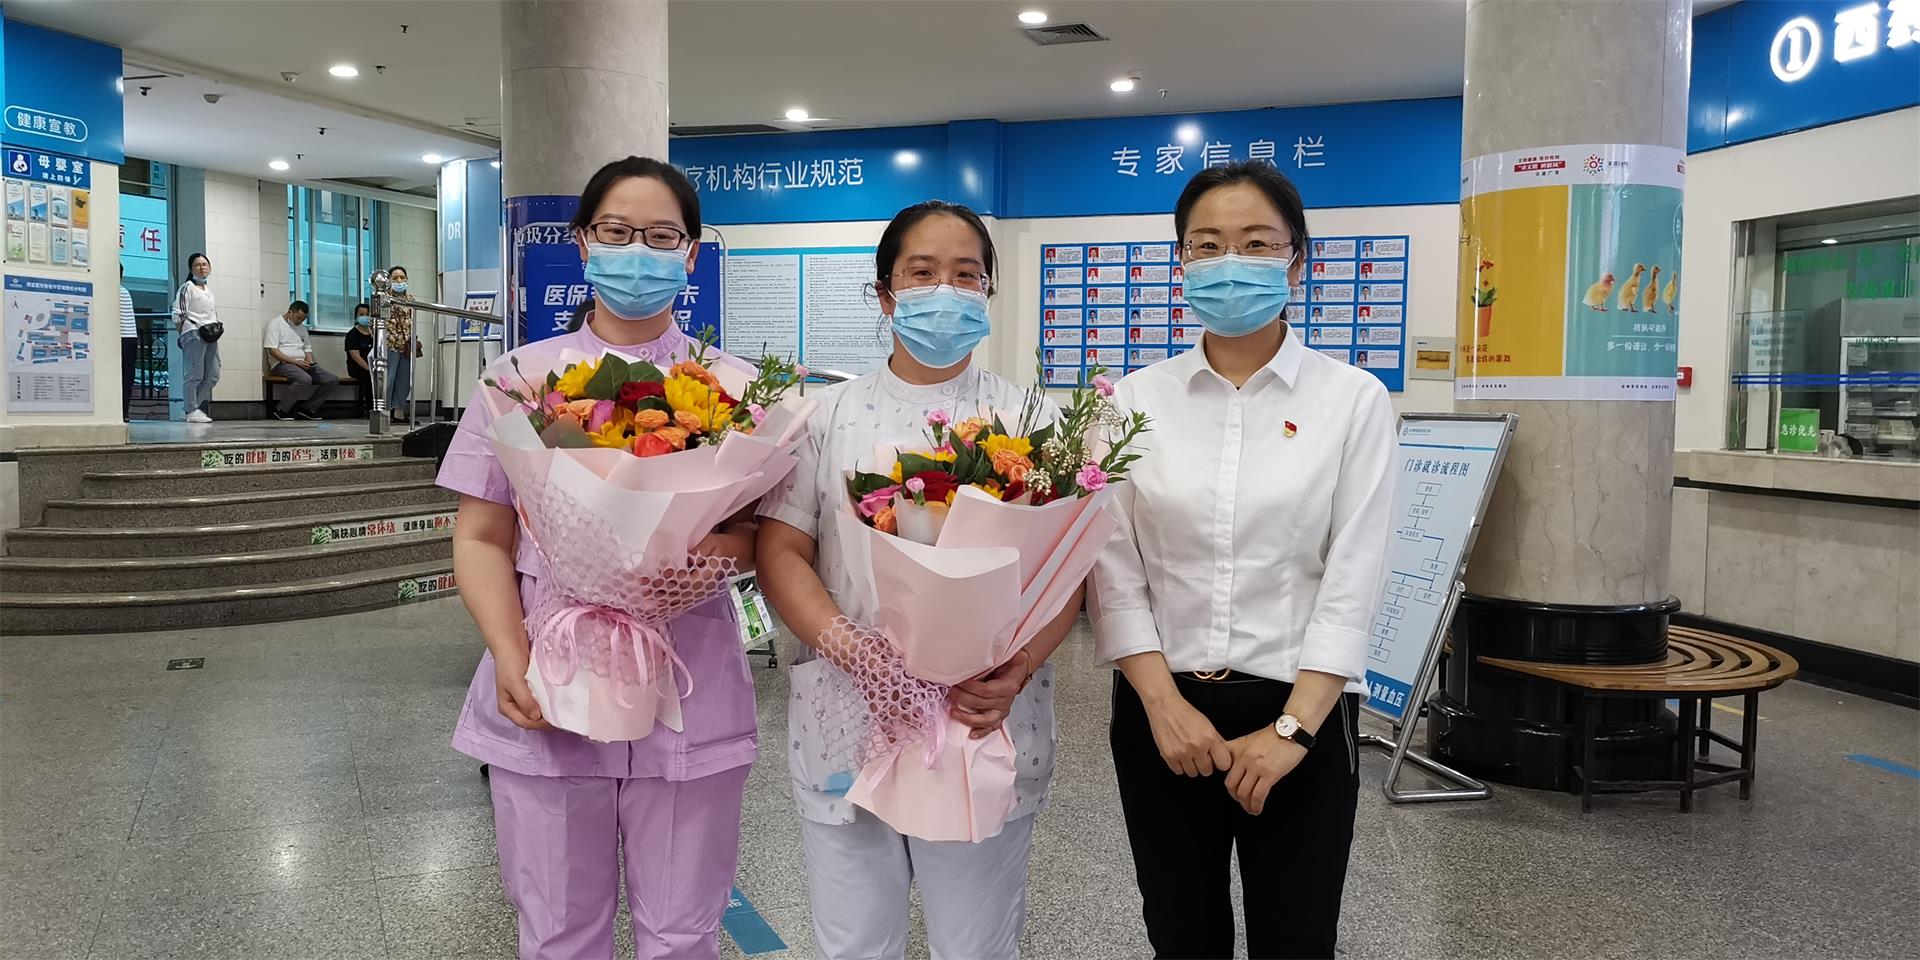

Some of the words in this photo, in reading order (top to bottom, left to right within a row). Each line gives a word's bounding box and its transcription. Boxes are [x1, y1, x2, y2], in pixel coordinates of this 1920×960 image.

[17, 111, 77, 137] 健康宣教
[38, 155, 84, 175] 母婴室
[1111, 135, 1327, 177] 专家信息栏
[447, 223, 461, 240] DR
[543, 284, 597, 306] 医保
[1780, 424, 1816, 438] 急诊优先
[224, 451, 267, 465] 吃的健康
[1404, 458, 1470, 477] 门诊就诊流程图
[403, 515, 458, 531] 健康身心跑不
